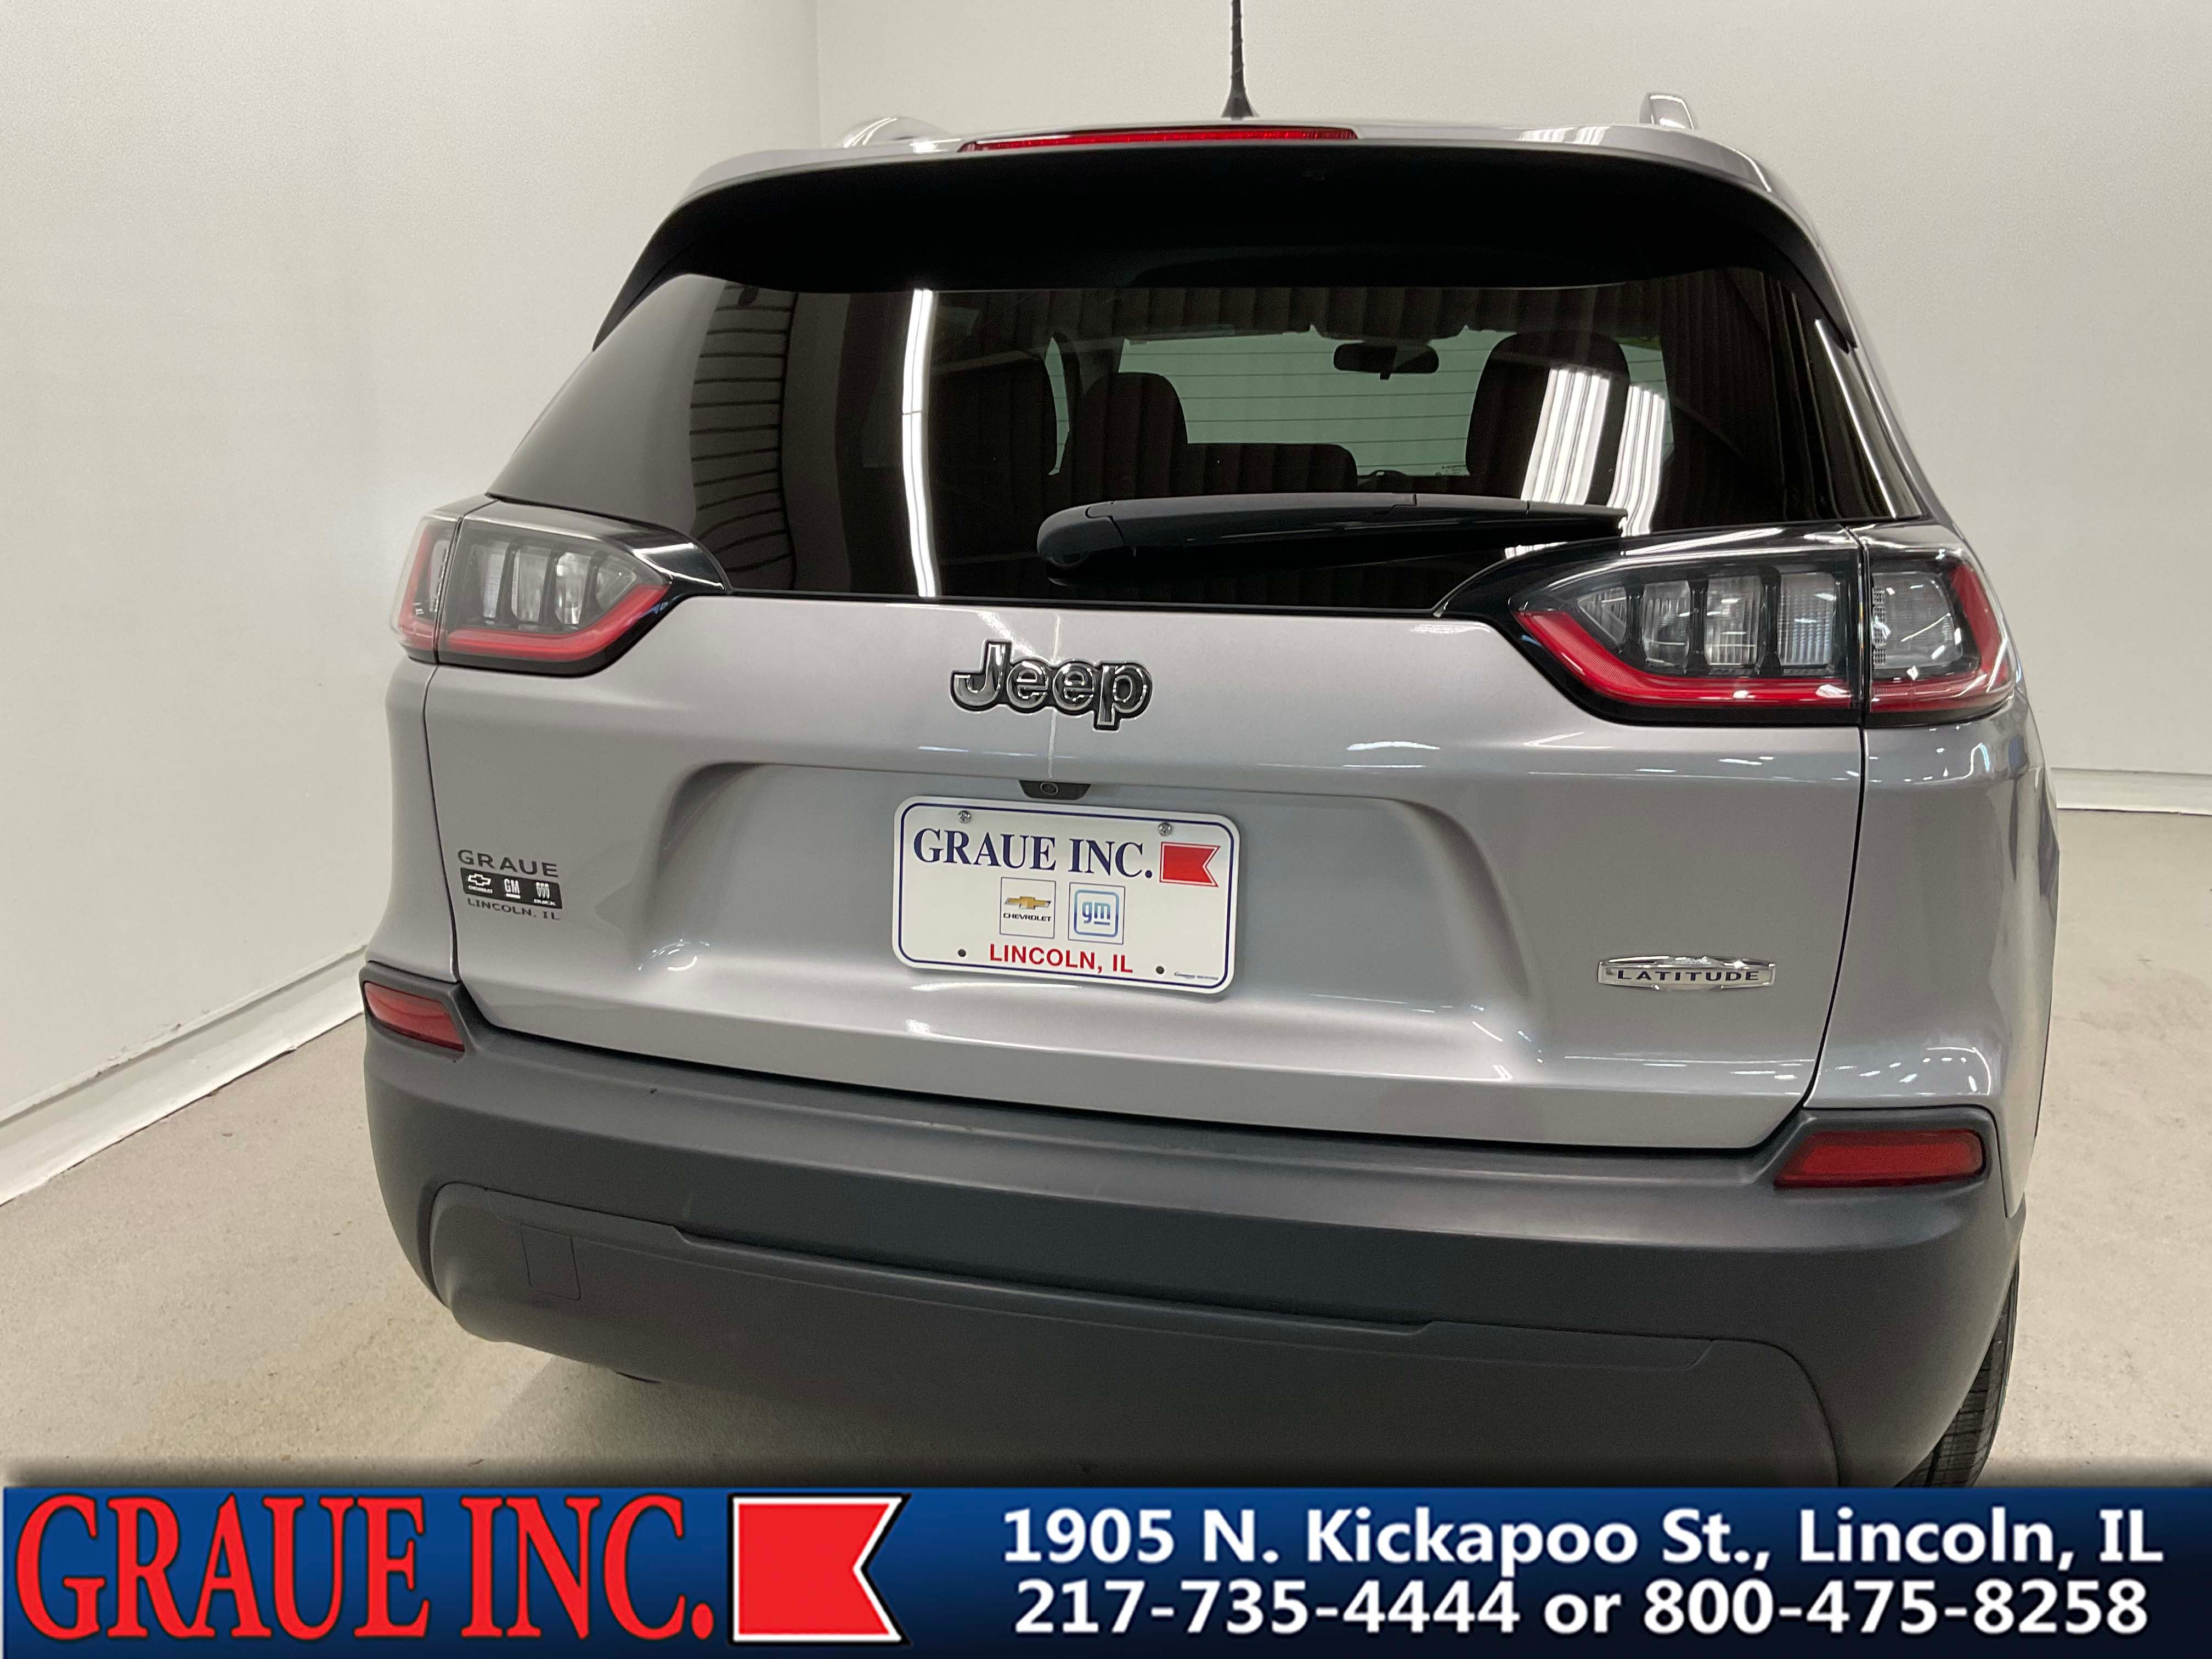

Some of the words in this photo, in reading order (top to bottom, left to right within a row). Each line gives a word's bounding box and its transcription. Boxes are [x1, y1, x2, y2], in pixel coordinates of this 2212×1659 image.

[950, 640, 1152, 730] Jeep
[457, 849, 559, 878] GRAUE
[913, 828, 1057, 871] GRAUE
[1068, 838, 1153, 879] INC.
[504, 878, 521, 895] GM
[543, 911, 561, 921] IL
[1003, 912, 1052, 922] CHEVROLET
[1081, 901, 1111, 926] gm
[990, 943, 1103, 973] LINCOLN,
[1112, 953, 1133, 974] IL
[1617, 969, 1759, 981] LATITUDE
